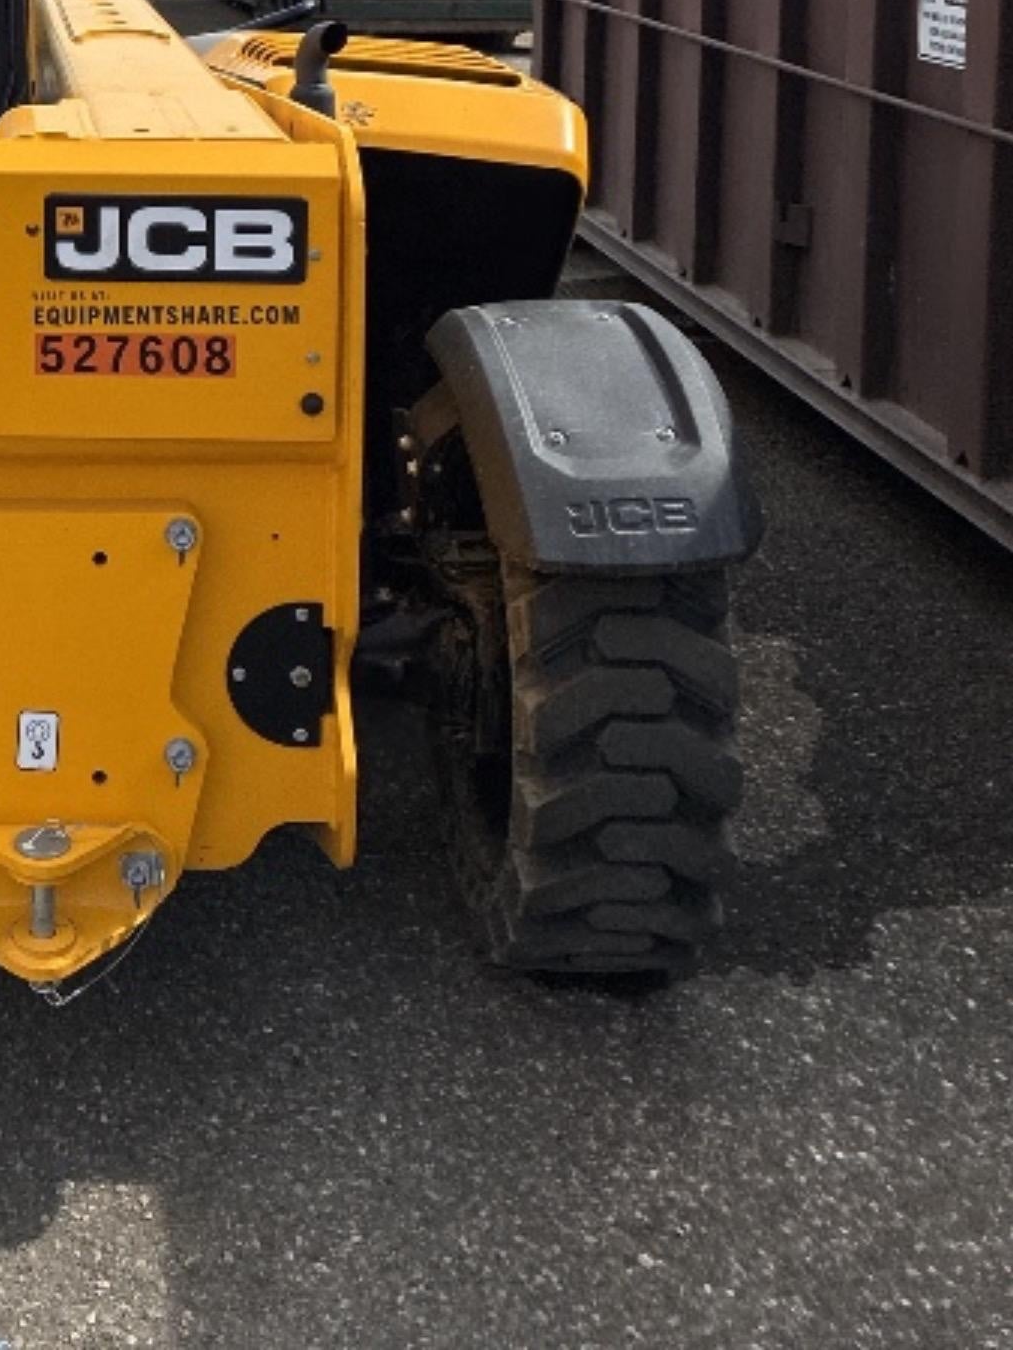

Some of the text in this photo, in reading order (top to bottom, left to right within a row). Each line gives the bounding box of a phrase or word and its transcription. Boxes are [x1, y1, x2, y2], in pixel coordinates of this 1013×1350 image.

[55, 206, 295, 272] JCB
[34, 305, 300, 327] EQUIPMENTSHARE.COM
[40, 335, 232, 374] 527608
[565, 497, 699, 538] JCB
